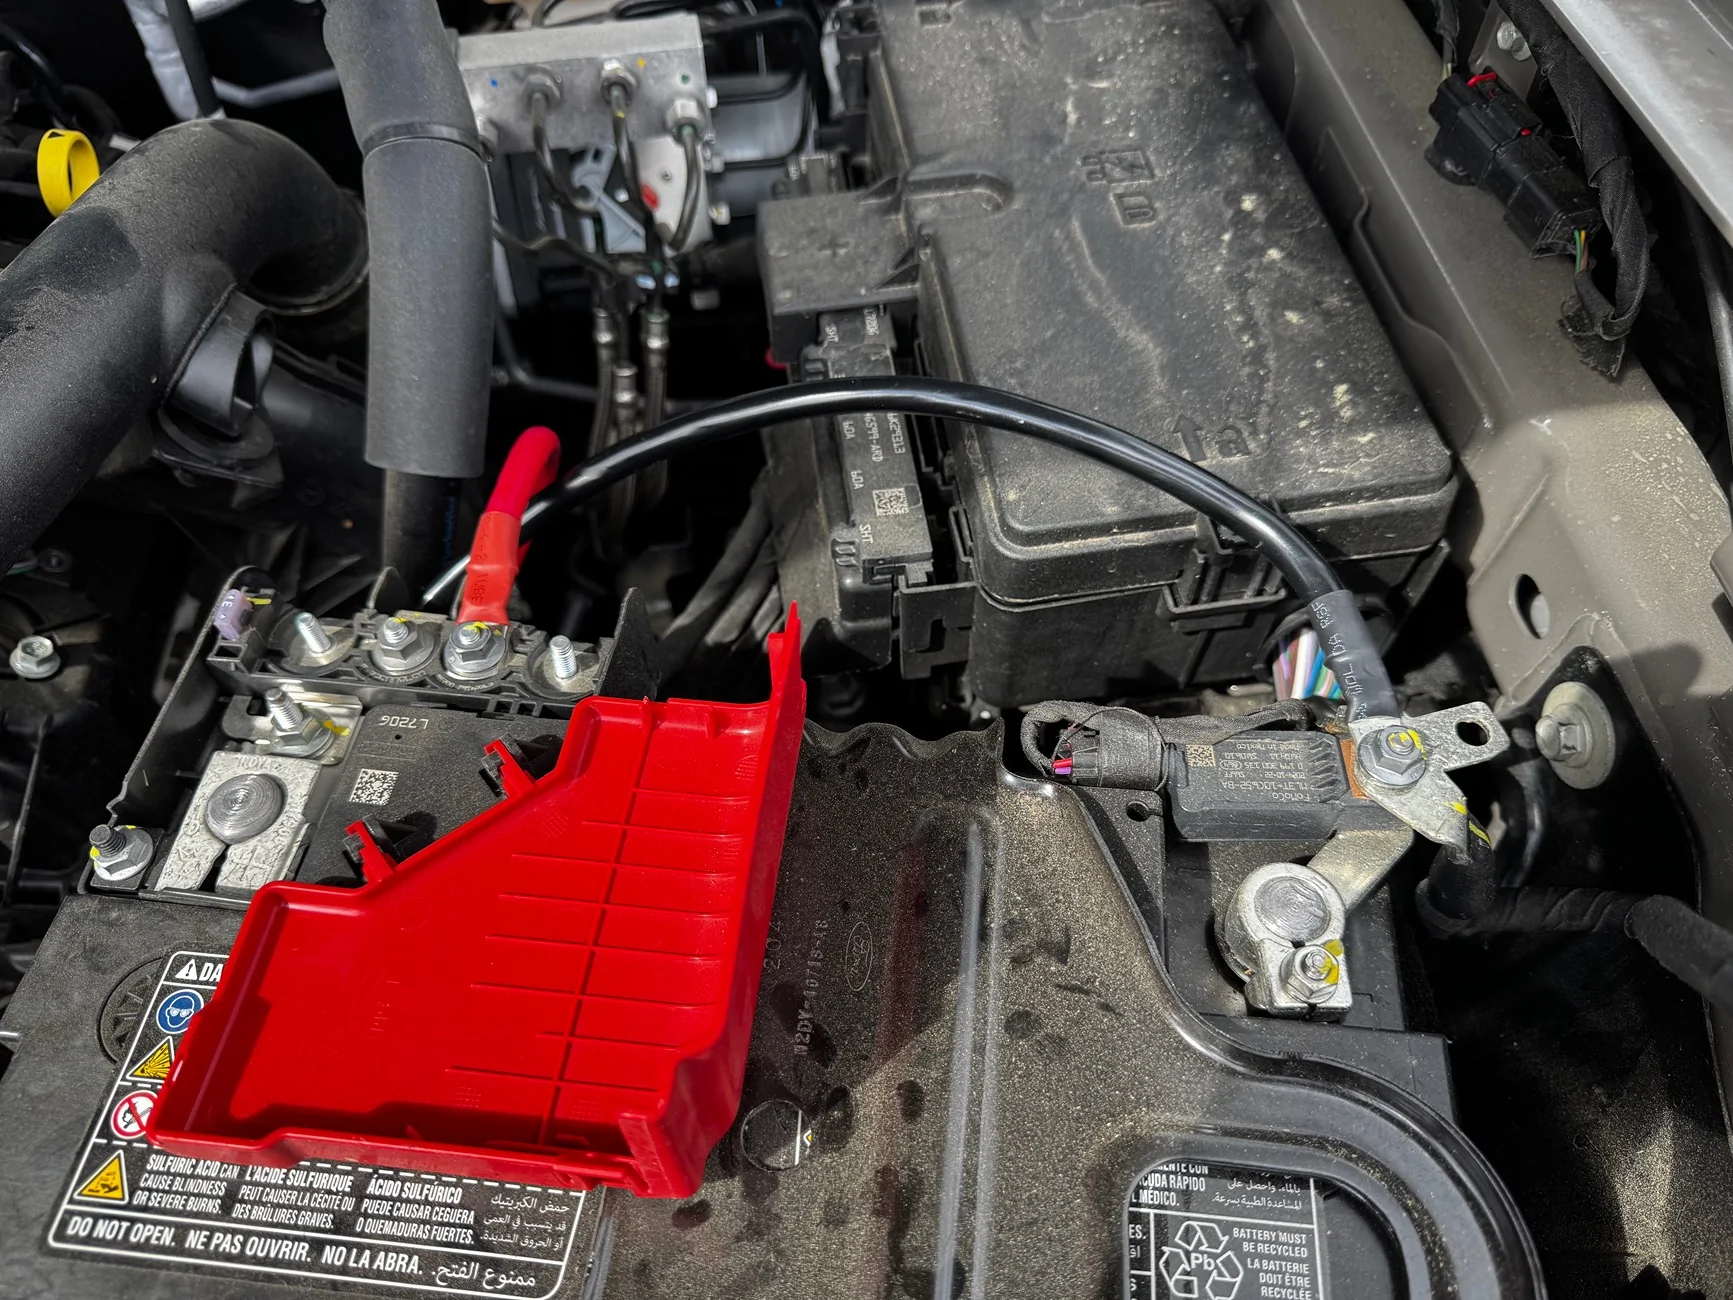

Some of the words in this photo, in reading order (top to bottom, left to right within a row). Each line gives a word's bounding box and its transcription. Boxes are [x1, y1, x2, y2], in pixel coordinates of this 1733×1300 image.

[850, 469, 864, 490] 60A
[859, 523, 874, 544] SHT
[146, 1154, 196, 1174] SULFURIC
[194, 1159, 220, 1178] ACID
[220, 1164, 240, 1179] CAN
[140, 1173, 173, 1191] CAUSE
[172, 1177, 227, 1196] BLINDNESS
[286, 1169, 354, 1192] SULFURIQUE
[367, 1174, 401, 1197] ÁCIDO
[400, 1180, 463, 1205] SULFÚRICO
[1139, 1172, 1168, 1188] CUDA
[1169, 1172, 1206, 1191] RÁPIDO
[1227, 1177, 1243, 1190] على
[132, 1191, 151, 1205] OR
[148, 1192, 188, 1210] SEVERE
[186, 1197, 222, 1214] BURNS.
[238, 1185, 263, 1201] PEUT
[262, 1187, 298, 1206] CAUSER
[297, 1191, 309, 1206] LA
[310, 1192, 342, 1210] CÉCITÉ
[341, 1197, 355, 1211] OU
[491, 1193, 537, 1211] الكبريتيك
[1138, 1186, 1180, 1206] MÉDICO.
[232, 1203, 251, 1218] DES
[250, 1204, 298, 1225] BRÛLURES
[297, 1210, 334, 1229] GRAVES.
[361, 1198, 392, 1218] PUEDE
[392, 1202, 431, 1222] CAUSAR
[431, 1206, 475, 1225] CEGUERA
[539, 1200, 570, 1213] حمض
[356, 1217, 364, 1232] O
[364, 1218, 430, 1240] QUEMADURAS
[430, 1224, 475, 1245] FUERTES.
[512, 1217, 521, 1229] في
[524, 1218, 552, 1232] يتسبب
[555, 1221, 567, 1231] قد
[67, 1215, 95, 1237] DO
[97, 1217, 131, 1241] NOT
[129, 1221, 176, 1246] OPEN.
[185, 1230, 210, 1250] NE
[210, 1232, 244, 1254] PAS
[245, 1236, 311, 1262] OUVRIR.
[321, 1245, 347, 1265] NO
[349, 1248, 370, 1269] LA
[373, 1252, 423, 1275] ABRA.
[520, 1236, 551, 1249] الحروق
[554, 1236, 563, 1251] أو
[1233, 1227, 1276, 1242] BATTERY
[1278, 1231, 1307, 1244] MUST
[1243, 1241, 1256, 1252] BE
[1257, 1243, 1308, 1258] RECYCLED
[1190, 1252, 1215, 1271] Pb
[1247, 1257, 1260, 1269] LA
[1262, 1259, 1310, 1274] BATTERIE
[432, 1261, 479, 1285] الفتح.
[483, 1269, 535, 1289] ممنوع
[1259, 1272, 1283, 1285] DOIT
[1285, 1273, 1311, 1288] ÊTRE
[1261, 1286, 1312, 1300] RECYCLÉE
